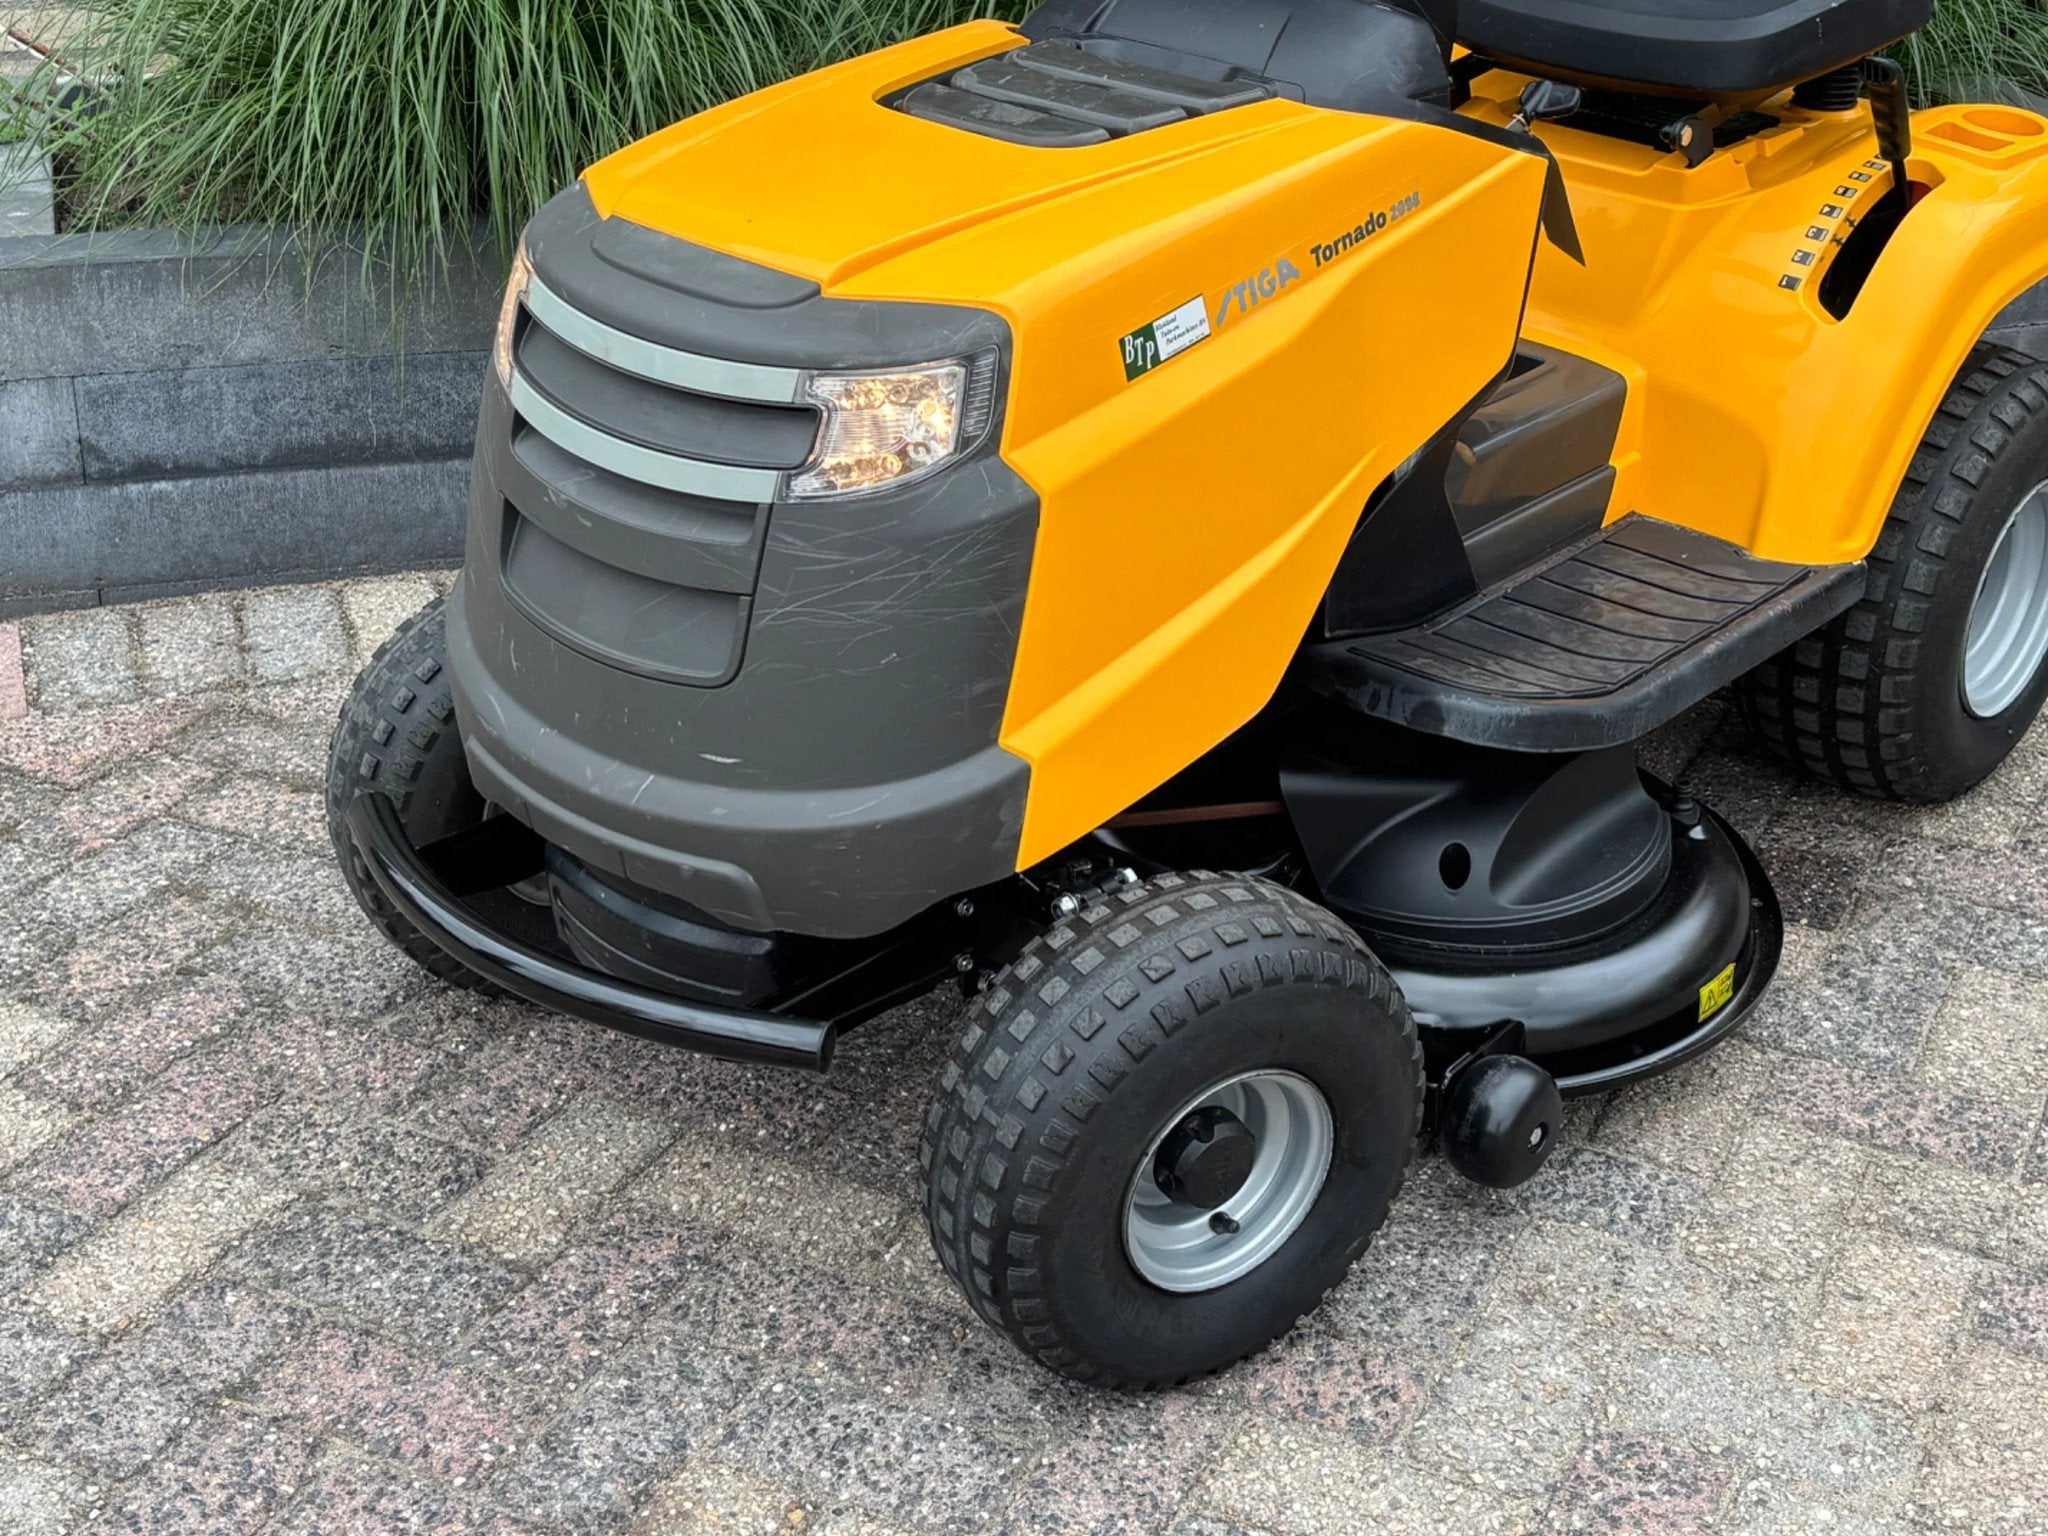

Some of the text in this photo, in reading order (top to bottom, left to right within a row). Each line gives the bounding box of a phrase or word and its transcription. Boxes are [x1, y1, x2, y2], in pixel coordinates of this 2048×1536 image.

[1216, 258, 1301, 327] STIGA
[1310, 212, 1387, 268] Tornado
[1125, 335, 1154, 370] BTP
